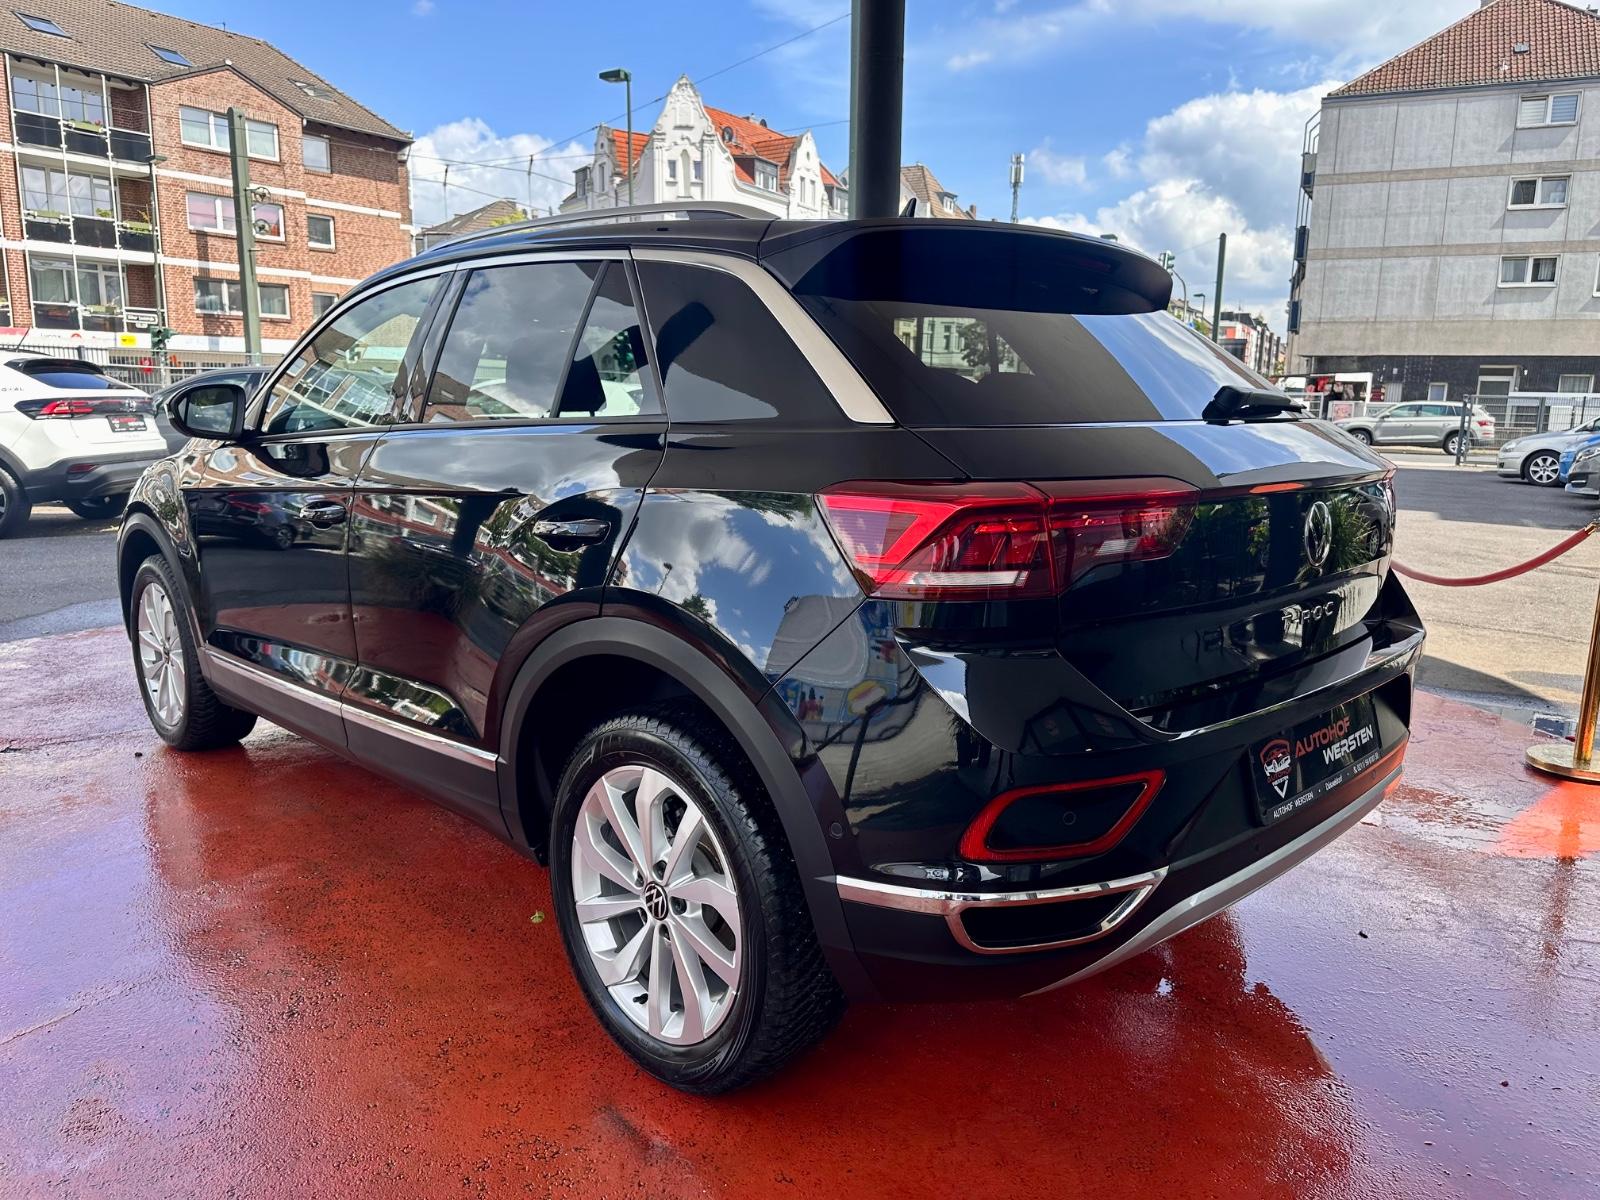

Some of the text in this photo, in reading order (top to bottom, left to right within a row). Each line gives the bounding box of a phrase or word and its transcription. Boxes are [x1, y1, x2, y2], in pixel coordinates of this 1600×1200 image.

[1295, 716, 1351, 758] AUTOHOF
[1323, 724, 1373, 765] WERSTEN
[1273, 801, 1294, 819] AUTOHOF
[1295, 791, 1314, 808] WERSTEN
